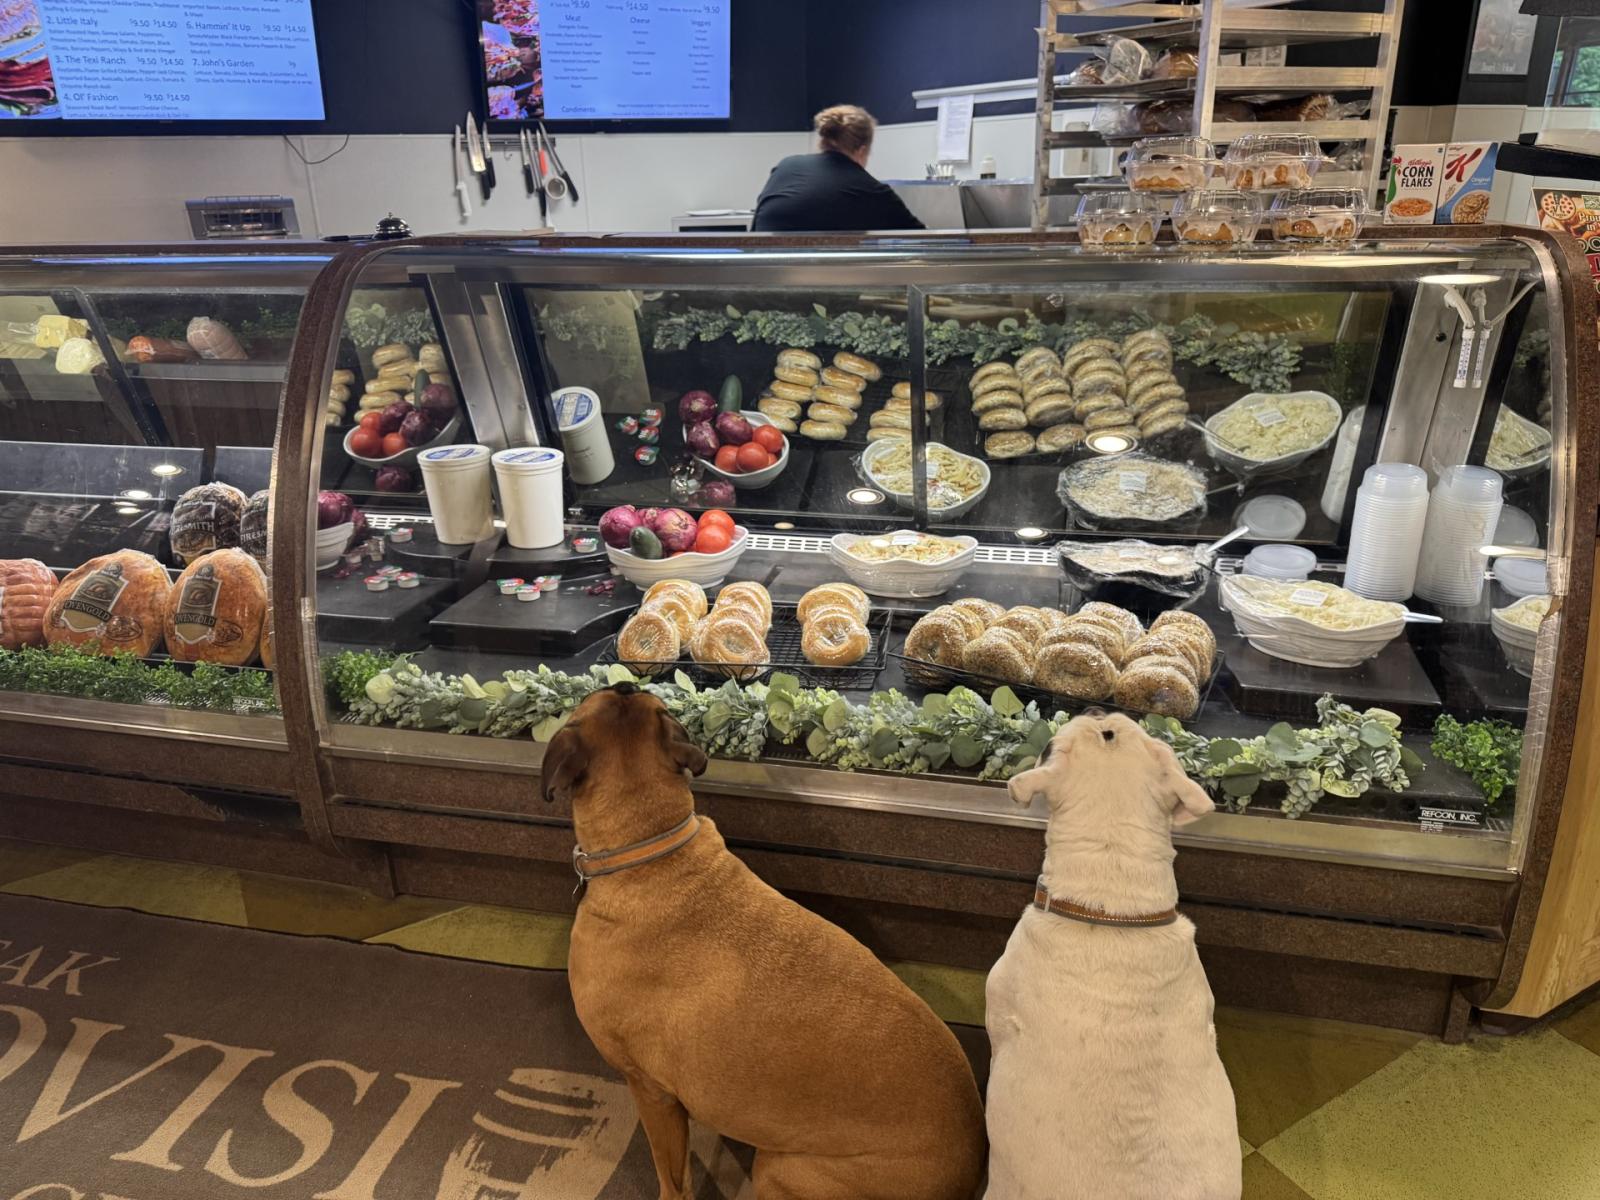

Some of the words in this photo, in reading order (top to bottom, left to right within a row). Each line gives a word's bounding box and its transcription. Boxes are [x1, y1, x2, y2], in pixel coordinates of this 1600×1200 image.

[56, 16, 78, 25] Little
[80, 16, 98, 27] Italy
[239, 23, 251, 32] Up
[64, 55, 80, 64] The
[100, 56, 126, 64] Ranch
[202, 58, 225, 67] John's
[226, 59, 255, 68] Garden
[87, 93, 119, 102] Fashion
[1445, 148, 1482, 182] K
[1402, 166, 1434, 178] CORN
[1401, 178, 1433, 188] FLAKES
[65, 600, 111, 621] OVENGOLD
[176, 613, 216, 626] OVENGOLD
[1421, 810, 1456, 820] REFCON,
[1460, 814, 1477, 822] INC.
